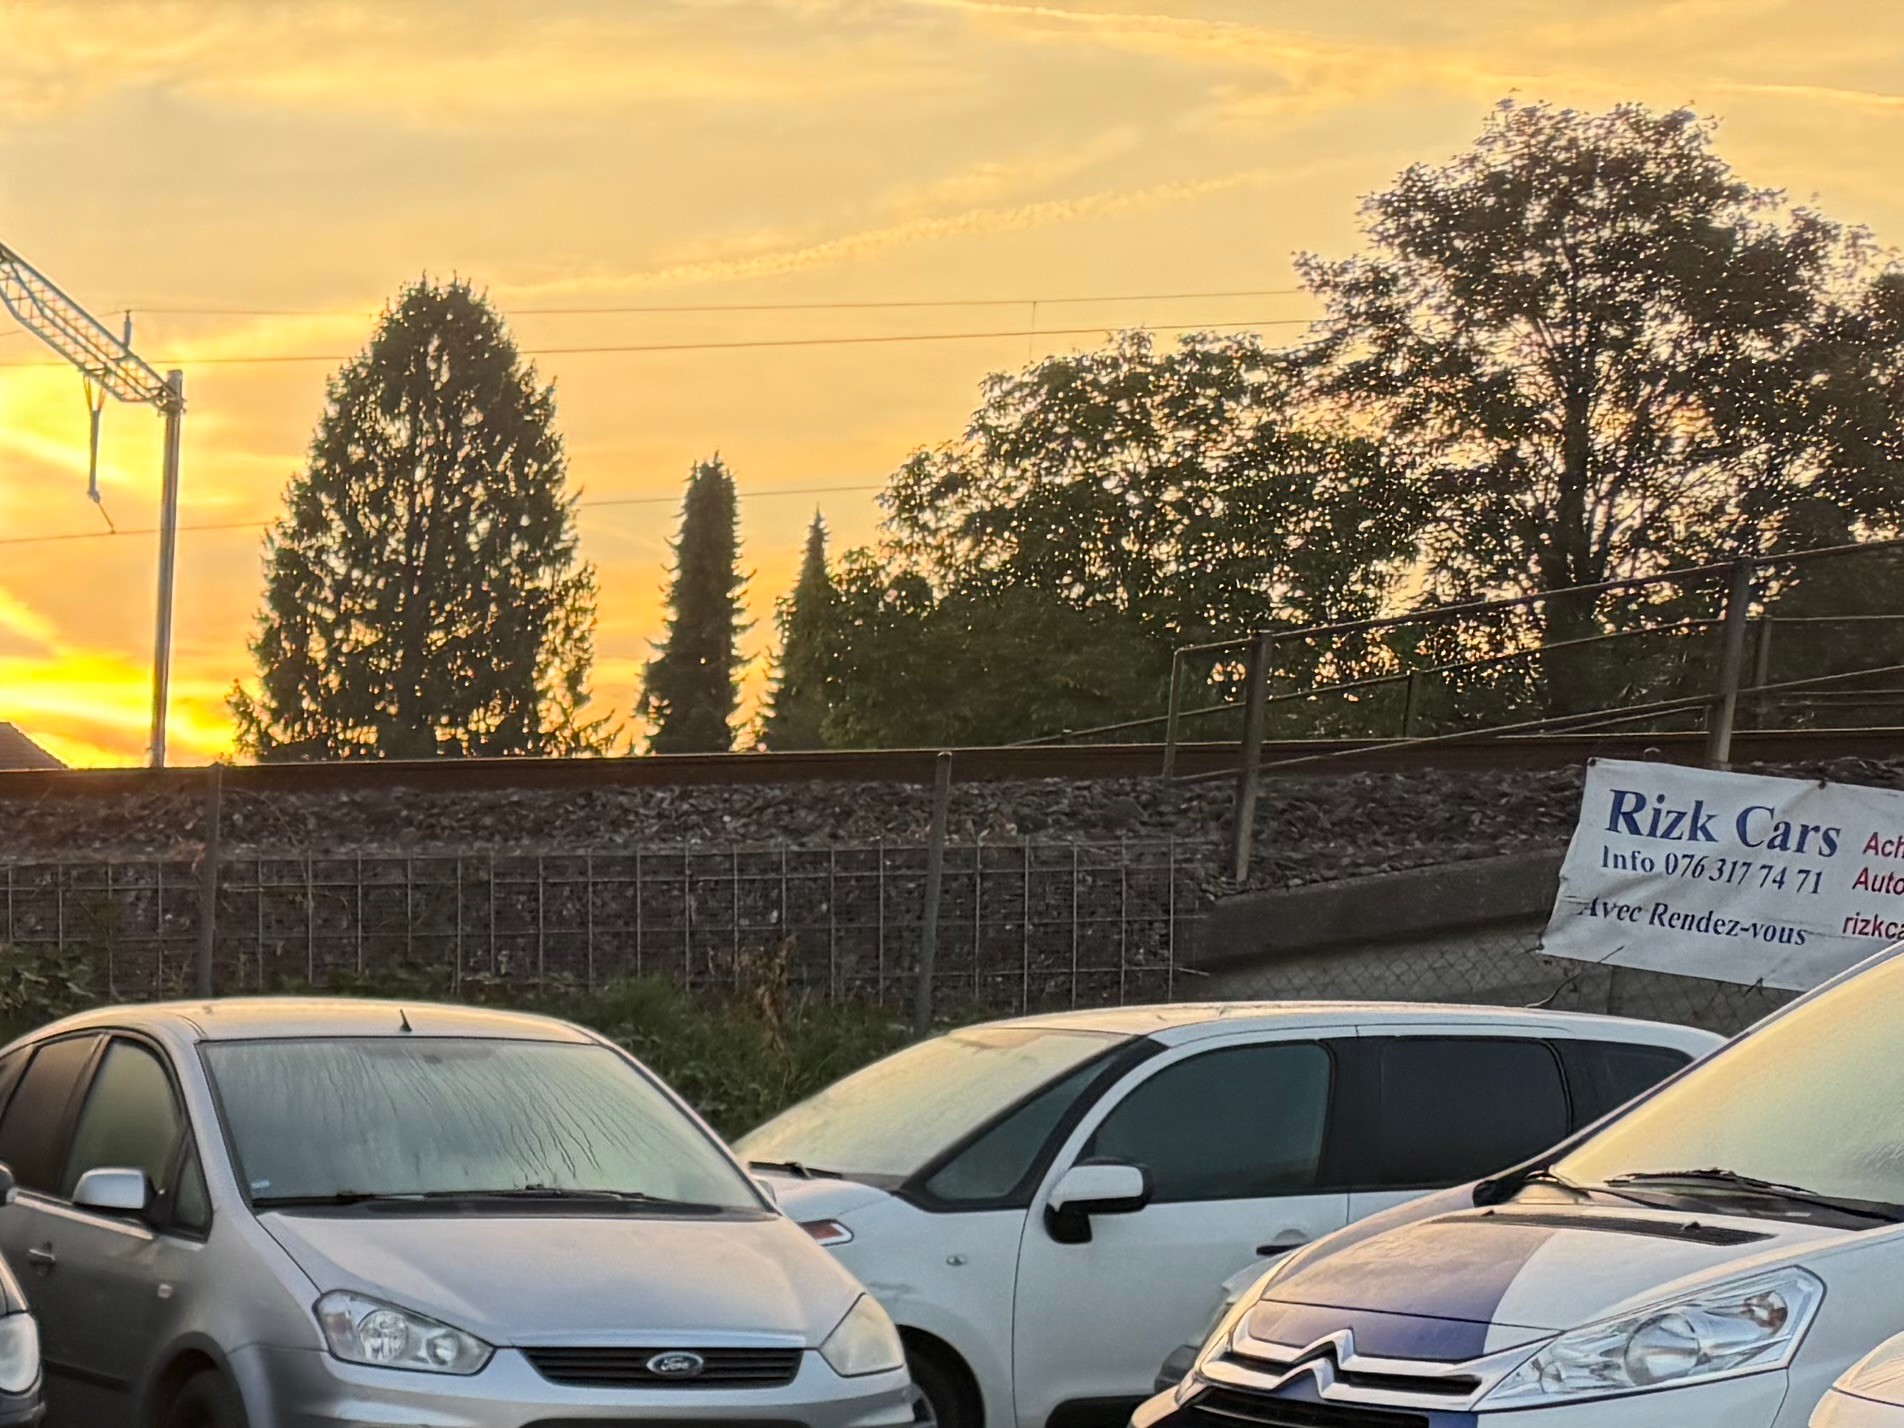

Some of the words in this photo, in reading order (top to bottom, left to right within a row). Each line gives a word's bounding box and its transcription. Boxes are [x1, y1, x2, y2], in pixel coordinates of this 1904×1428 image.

[1604, 789, 1719, 843] Rizk
[1736, 806, 1841, 858] Cars
[1602, 845, 1655, 873] Info
[1665, 853, 1708, 879] 076
[1708, 858, 1753, 886] 317
[1759, 864, 1788, 890] 74
[1796, 869, 1823, 894] 71
[1576, 897, 1642, 922] Avec
[1649, 902, 1808, 945] Rendez-vous
